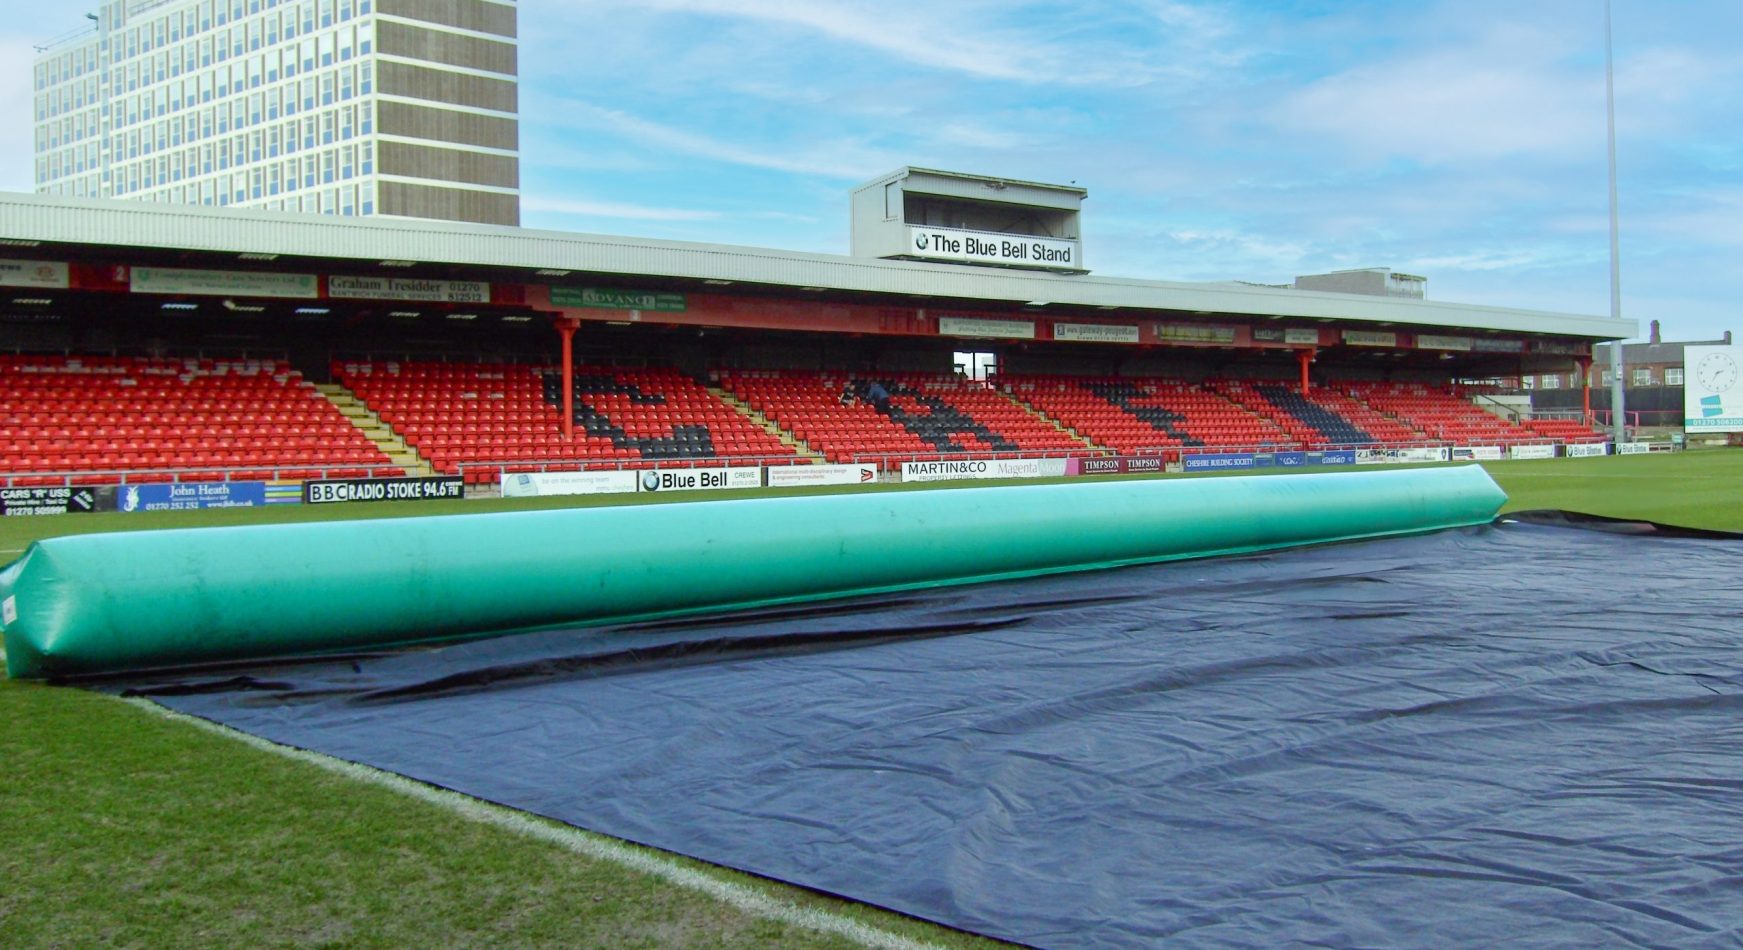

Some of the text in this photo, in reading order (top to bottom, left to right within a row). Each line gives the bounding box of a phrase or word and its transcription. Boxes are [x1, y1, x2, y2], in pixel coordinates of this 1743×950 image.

[932, 235, 1071, 262] The Blue Bell Stand
[116, 266, 125, 280] 2
[330, 277, 480, 292] Graham Tresidder 01270
[447, 291, 481, 302] 812512
[908, 461, 987, 475] MARTIN&CO
[997, 461, 1038, 476] Magenta
[1084, 460, 1119, 470] TIMPSON
[1127, 458, 1161, 468] TIMPSON
[1186, 459, 1209, 468] CHESHIRE
[1211, 458, 1233, 467] BUILDING
[1233, 457, 1253, 466] SOCIETY
[663, 473, 695, 488] Blue
[700, 471, 727, 487] Bell
[734, 471, 755, 479] CREWE
[0, 490, 30, 500] CARS
[49, 488, 71, 498] USS
[170, 484, 230, 497] John Heath
[311, 481, 446, 502] BBC RADIO STOKE 94.6
[448, 487, 459, 496] FM
[5, 508, 32, 516] 01270
[145, 502, 169, 511] 01270
[170, 502, 184, 510] 252
[185, 501, 199, 510] 252
